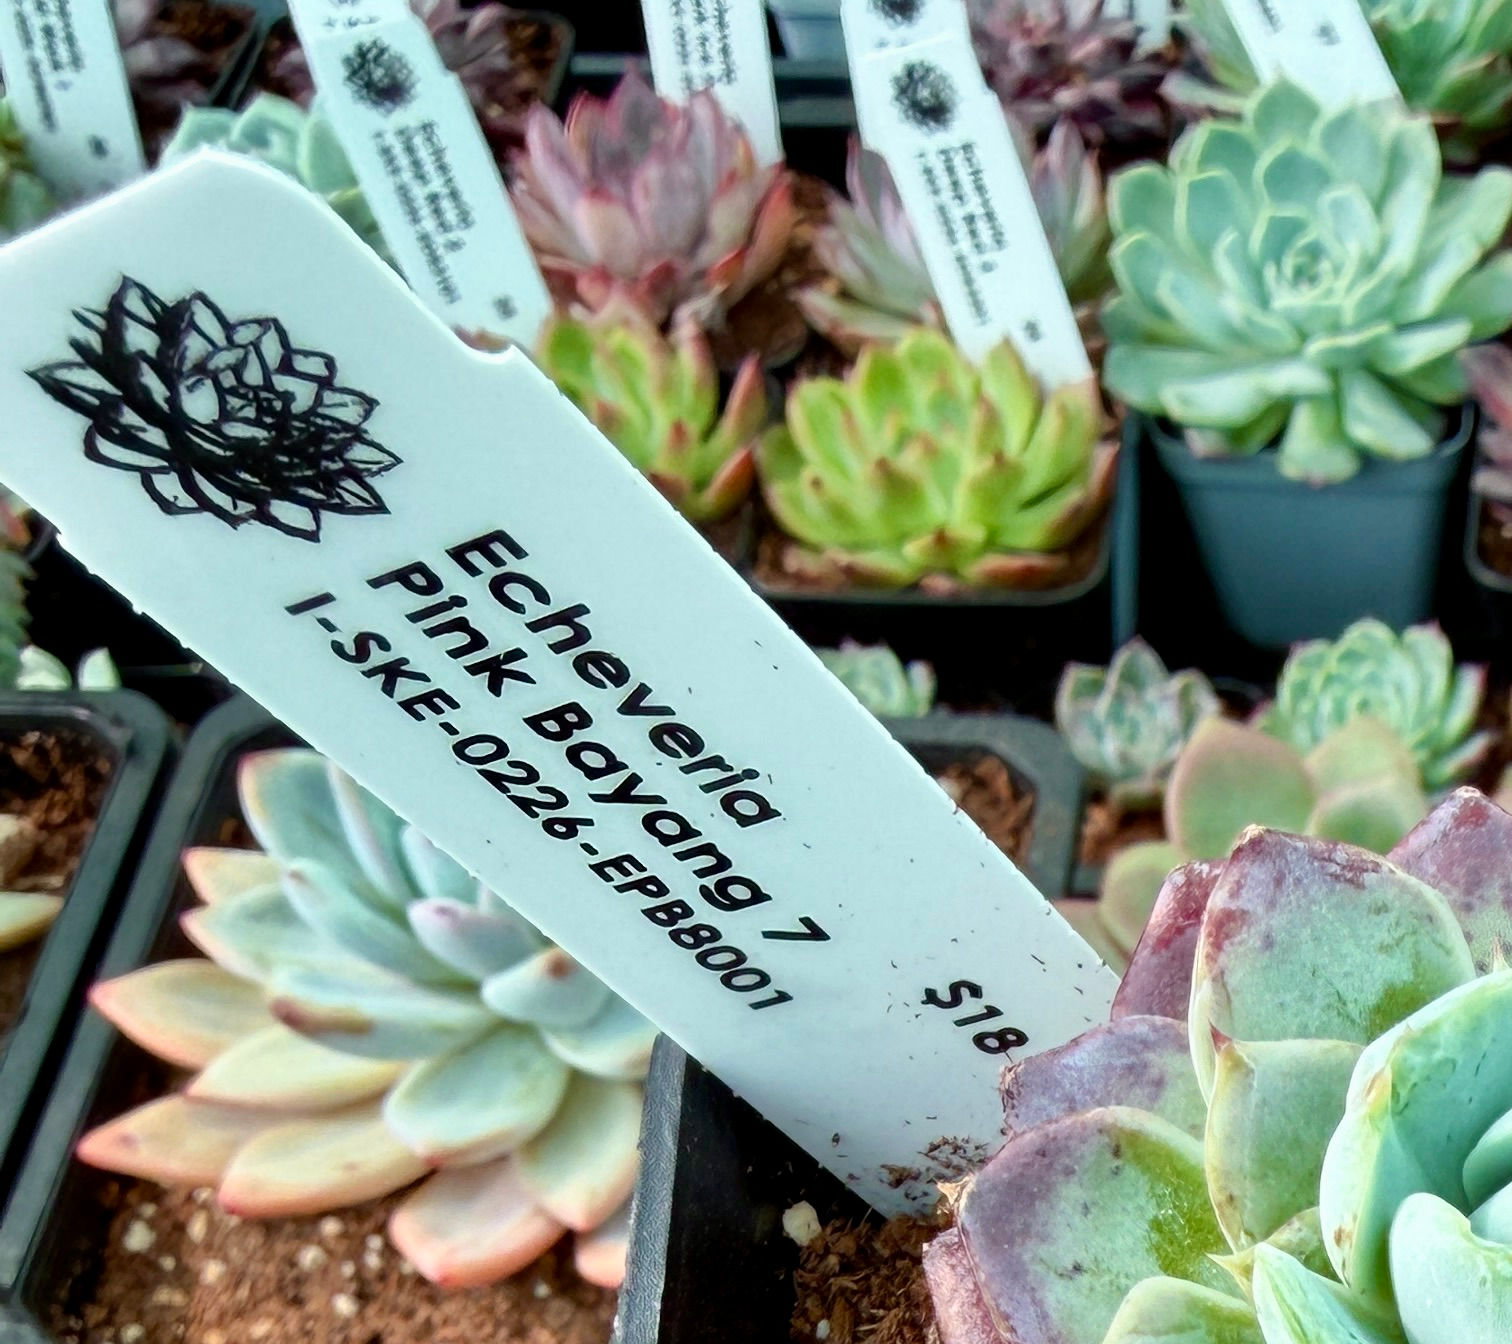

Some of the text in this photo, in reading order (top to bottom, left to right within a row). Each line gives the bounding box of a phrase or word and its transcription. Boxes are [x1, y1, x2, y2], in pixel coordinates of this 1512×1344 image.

[284, 592, 794, 1011] I-SKE-0226-EPB8001
[366, 560, 831, 942] Pink Bayang 7
[445, 529, 781, 828] Echeveria
[921, 979, 1029, 1056] $18
